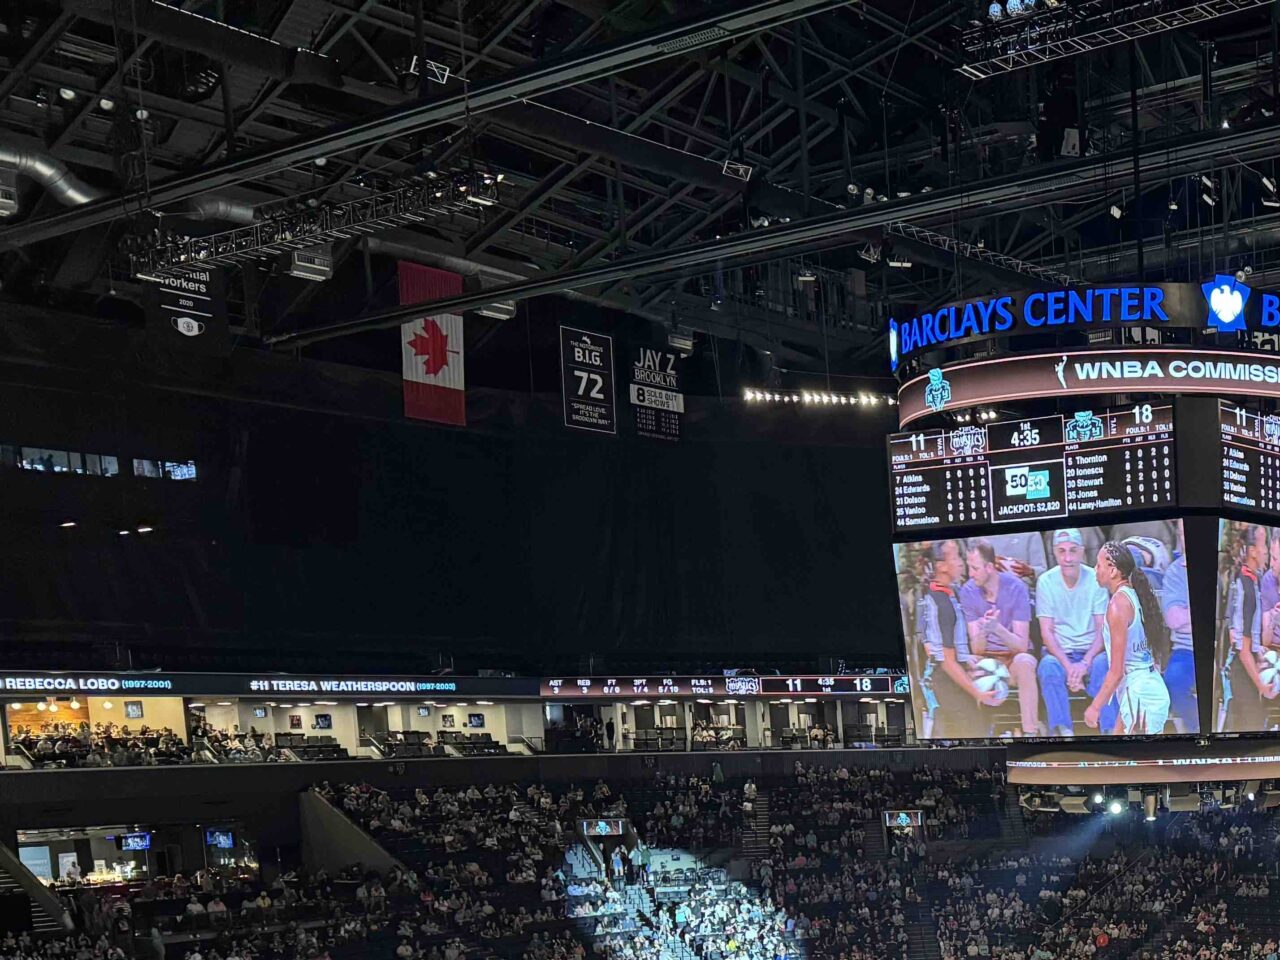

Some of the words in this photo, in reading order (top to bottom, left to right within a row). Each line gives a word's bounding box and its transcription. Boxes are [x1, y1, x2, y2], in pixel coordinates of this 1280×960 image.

[179, 299, 194, 307] 2020
[901, 297, 1012, 355] BARCLAYS
[1024, 287, 1169, 324] CENTER
[574, 347, 603, 366] B.I.G.
[635, 347, 661, 371] JAY
[666, 354, 676, 374] Z
[634, 368, 677, 387] BROOKLYN
[1074, 361, 1163, 381] WNBA
[574, 370, 604, 399] 72
[636, 387, 646, 403] 8
[647, 397, 671, 408] SHOWS
[1132, 404, 1152, 424] 18
[1235, 407, 1246, 426] 11
[1020, 422, 1031, 430] 1st
[911, 433, 925, 451] 11
[1010, 429, 1040, 447] 4:35
[1010, 474, 1027, 488] 50
[999, 503, 1036, 515] JACKPOT:
[1037, 501, 1060, 513] $2,820
[6, 678, 76, 689] REBECCA
[79, 678, 120, 690] LOBO
[250, 681, 269, 691] #11
[271, 681, 318, 691] TERESA
[320, 681, 415, 691] WEATHERSPOON
[786, 679, 801, 691] 11
[853, 678, 871, 691] 18
